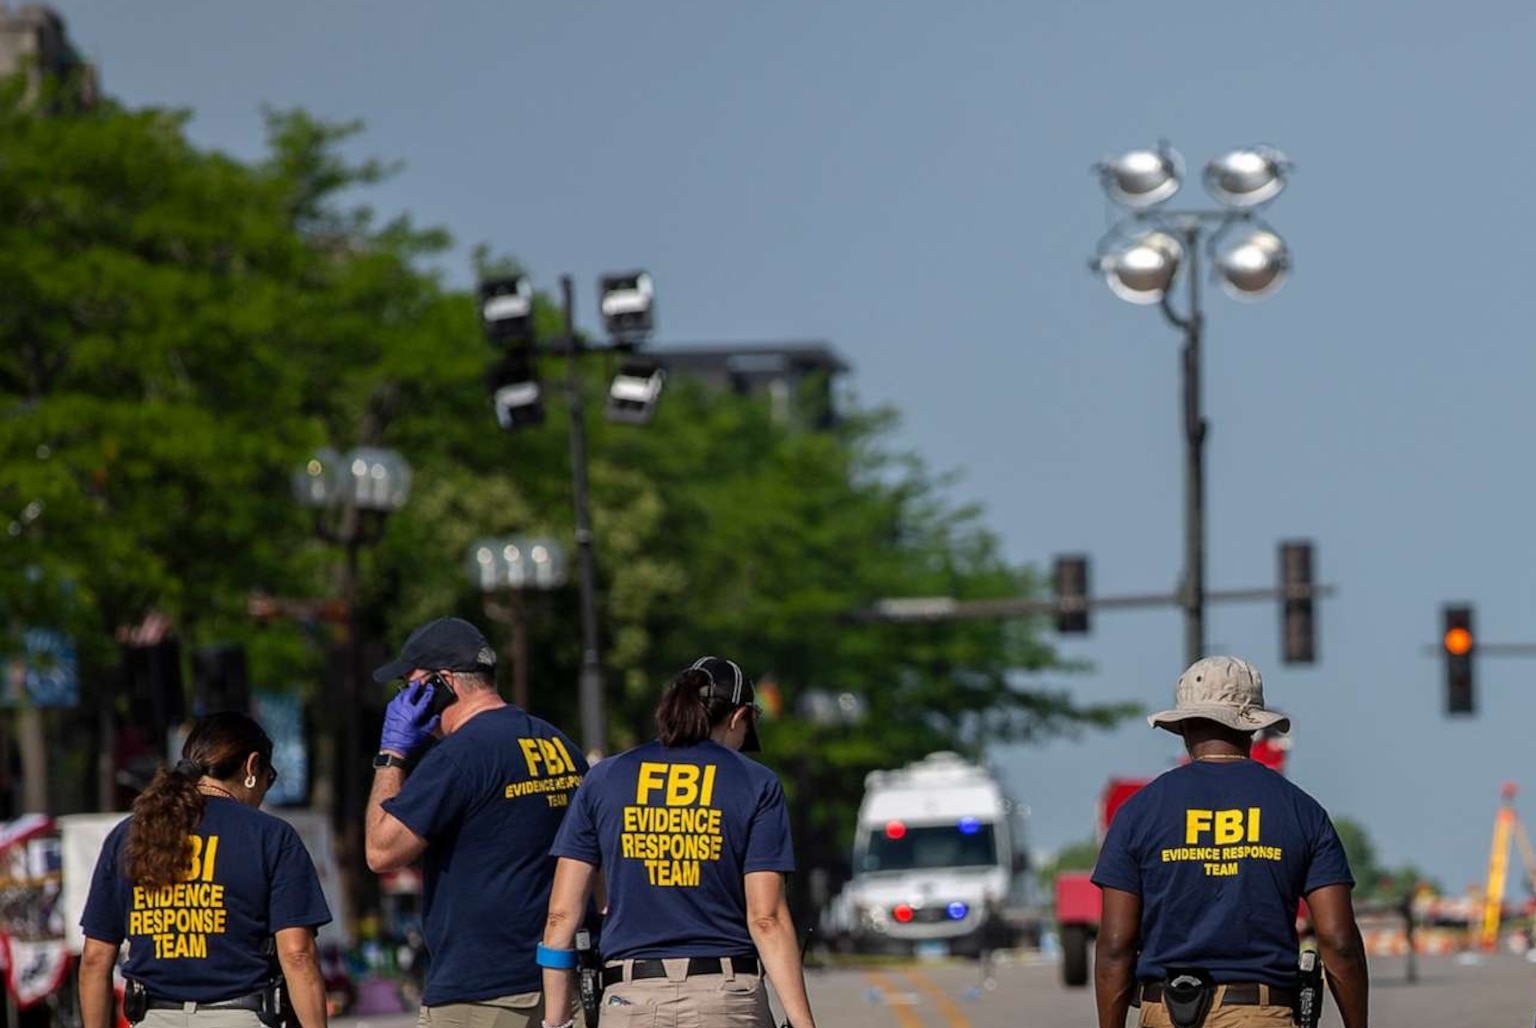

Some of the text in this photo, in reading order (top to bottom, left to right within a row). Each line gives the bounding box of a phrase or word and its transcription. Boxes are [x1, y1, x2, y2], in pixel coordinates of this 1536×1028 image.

[517, 736, 576, 777] FBI
[505, 779, 555, 799] EVIDENCE
[637, 762, 717, 808] FBI
[546, 793, 569, 808] TEAM
[623, 807, 722, 834] EVIDENCE
[1185, 807, 1261, 846] FBI
[181, 834, 219, 883] BI
[621, 832, 722, 861] RESPONSE
[1161, 845, 1282, 862] EVIDENCE RESPONSE
[645, 859, 701, 888] TEAM
[1203, 861, 1239, 877] TEAM
[133, 883, 225, 910] EVIDENCE
[129, 908, 227, 936] RESPONSE
[152, 932, 208, 960] TEAM
